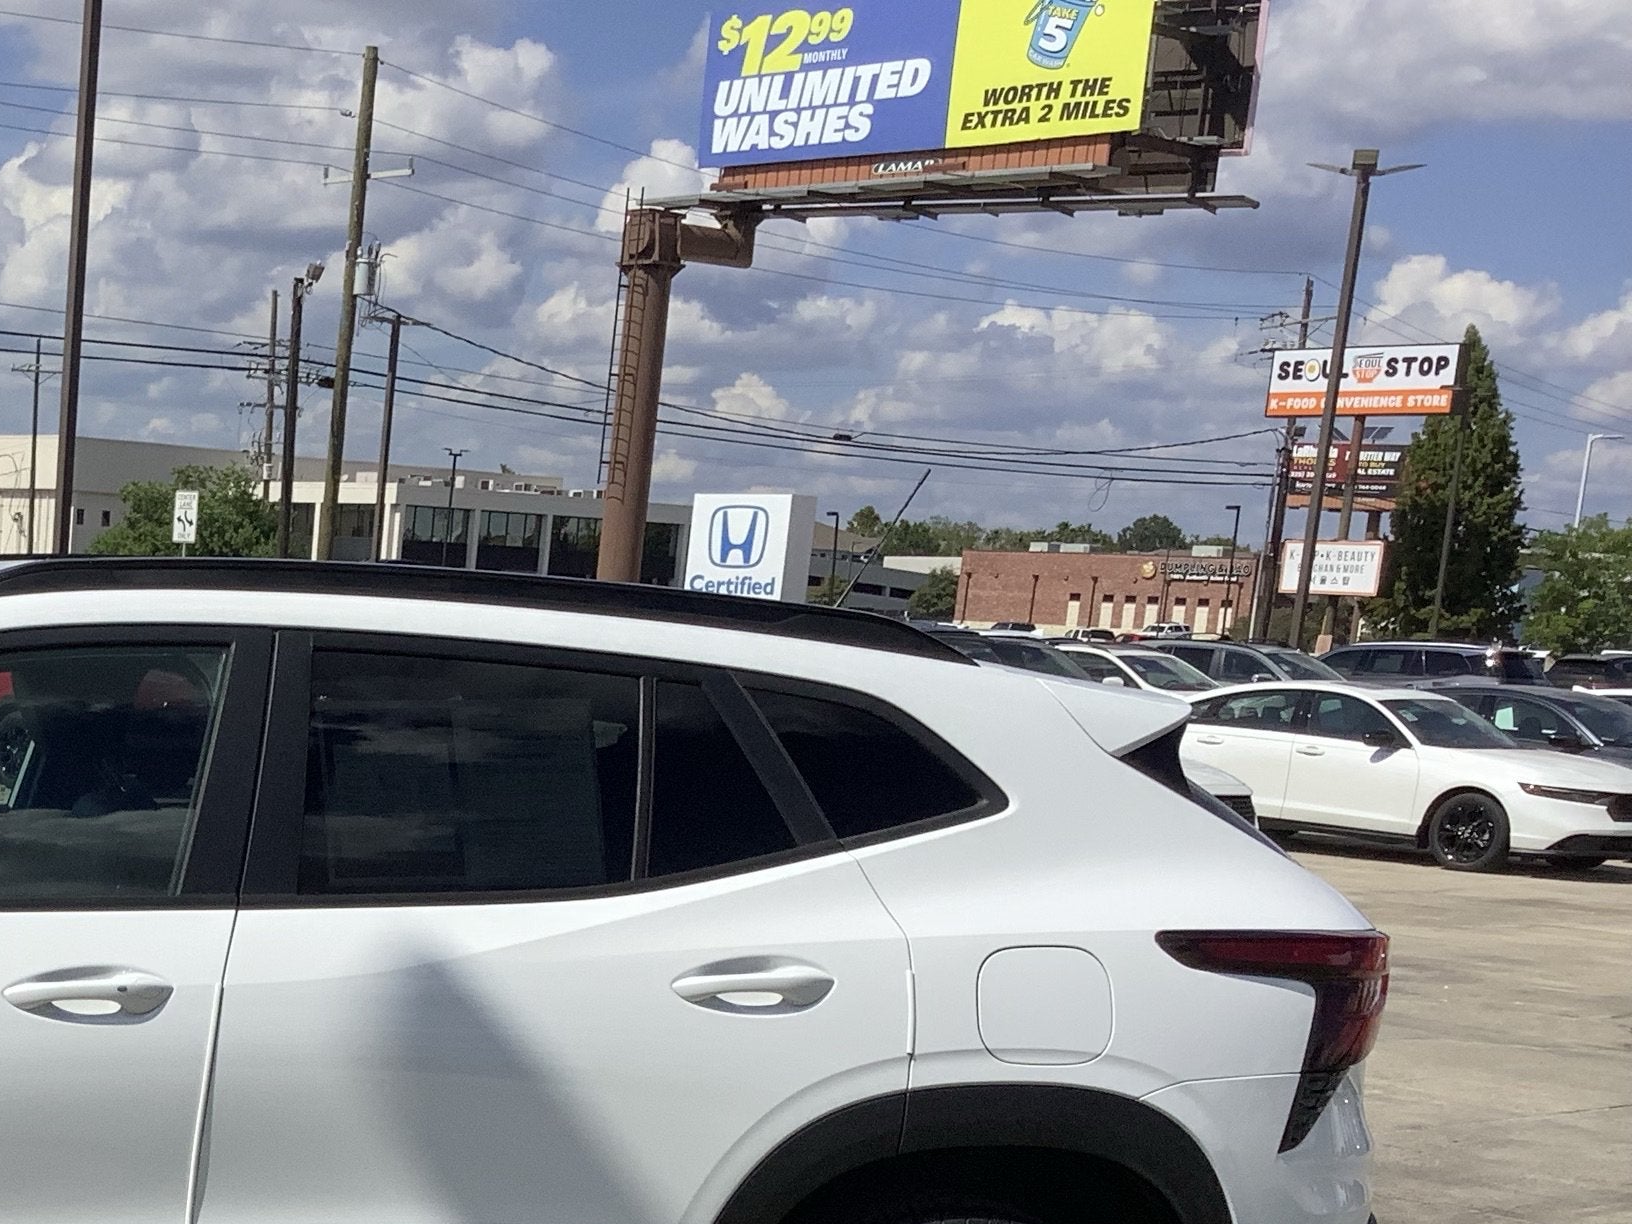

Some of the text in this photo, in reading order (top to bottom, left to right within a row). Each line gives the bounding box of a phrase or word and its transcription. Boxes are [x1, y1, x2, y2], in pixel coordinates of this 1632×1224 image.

[1048, 5, 1079, 20] TAKE
[1038, 16, 1074, 53] 5
[803, 48, 848, 64] MONTHLY
[713, 58, 932, 116] UNLIMITED
[983, 77, 1113, 107] WORTH THE
[960, 98, 1131, 131] EXTRA 2 MILES
[711, 103, 874, 154] WASHES
[1384, 355, 1450, 378] STOP
[1270, 393, 1449, 410] K-FOOD CNVENIENCE STORE
[689, 575, 776, 596] Certified
